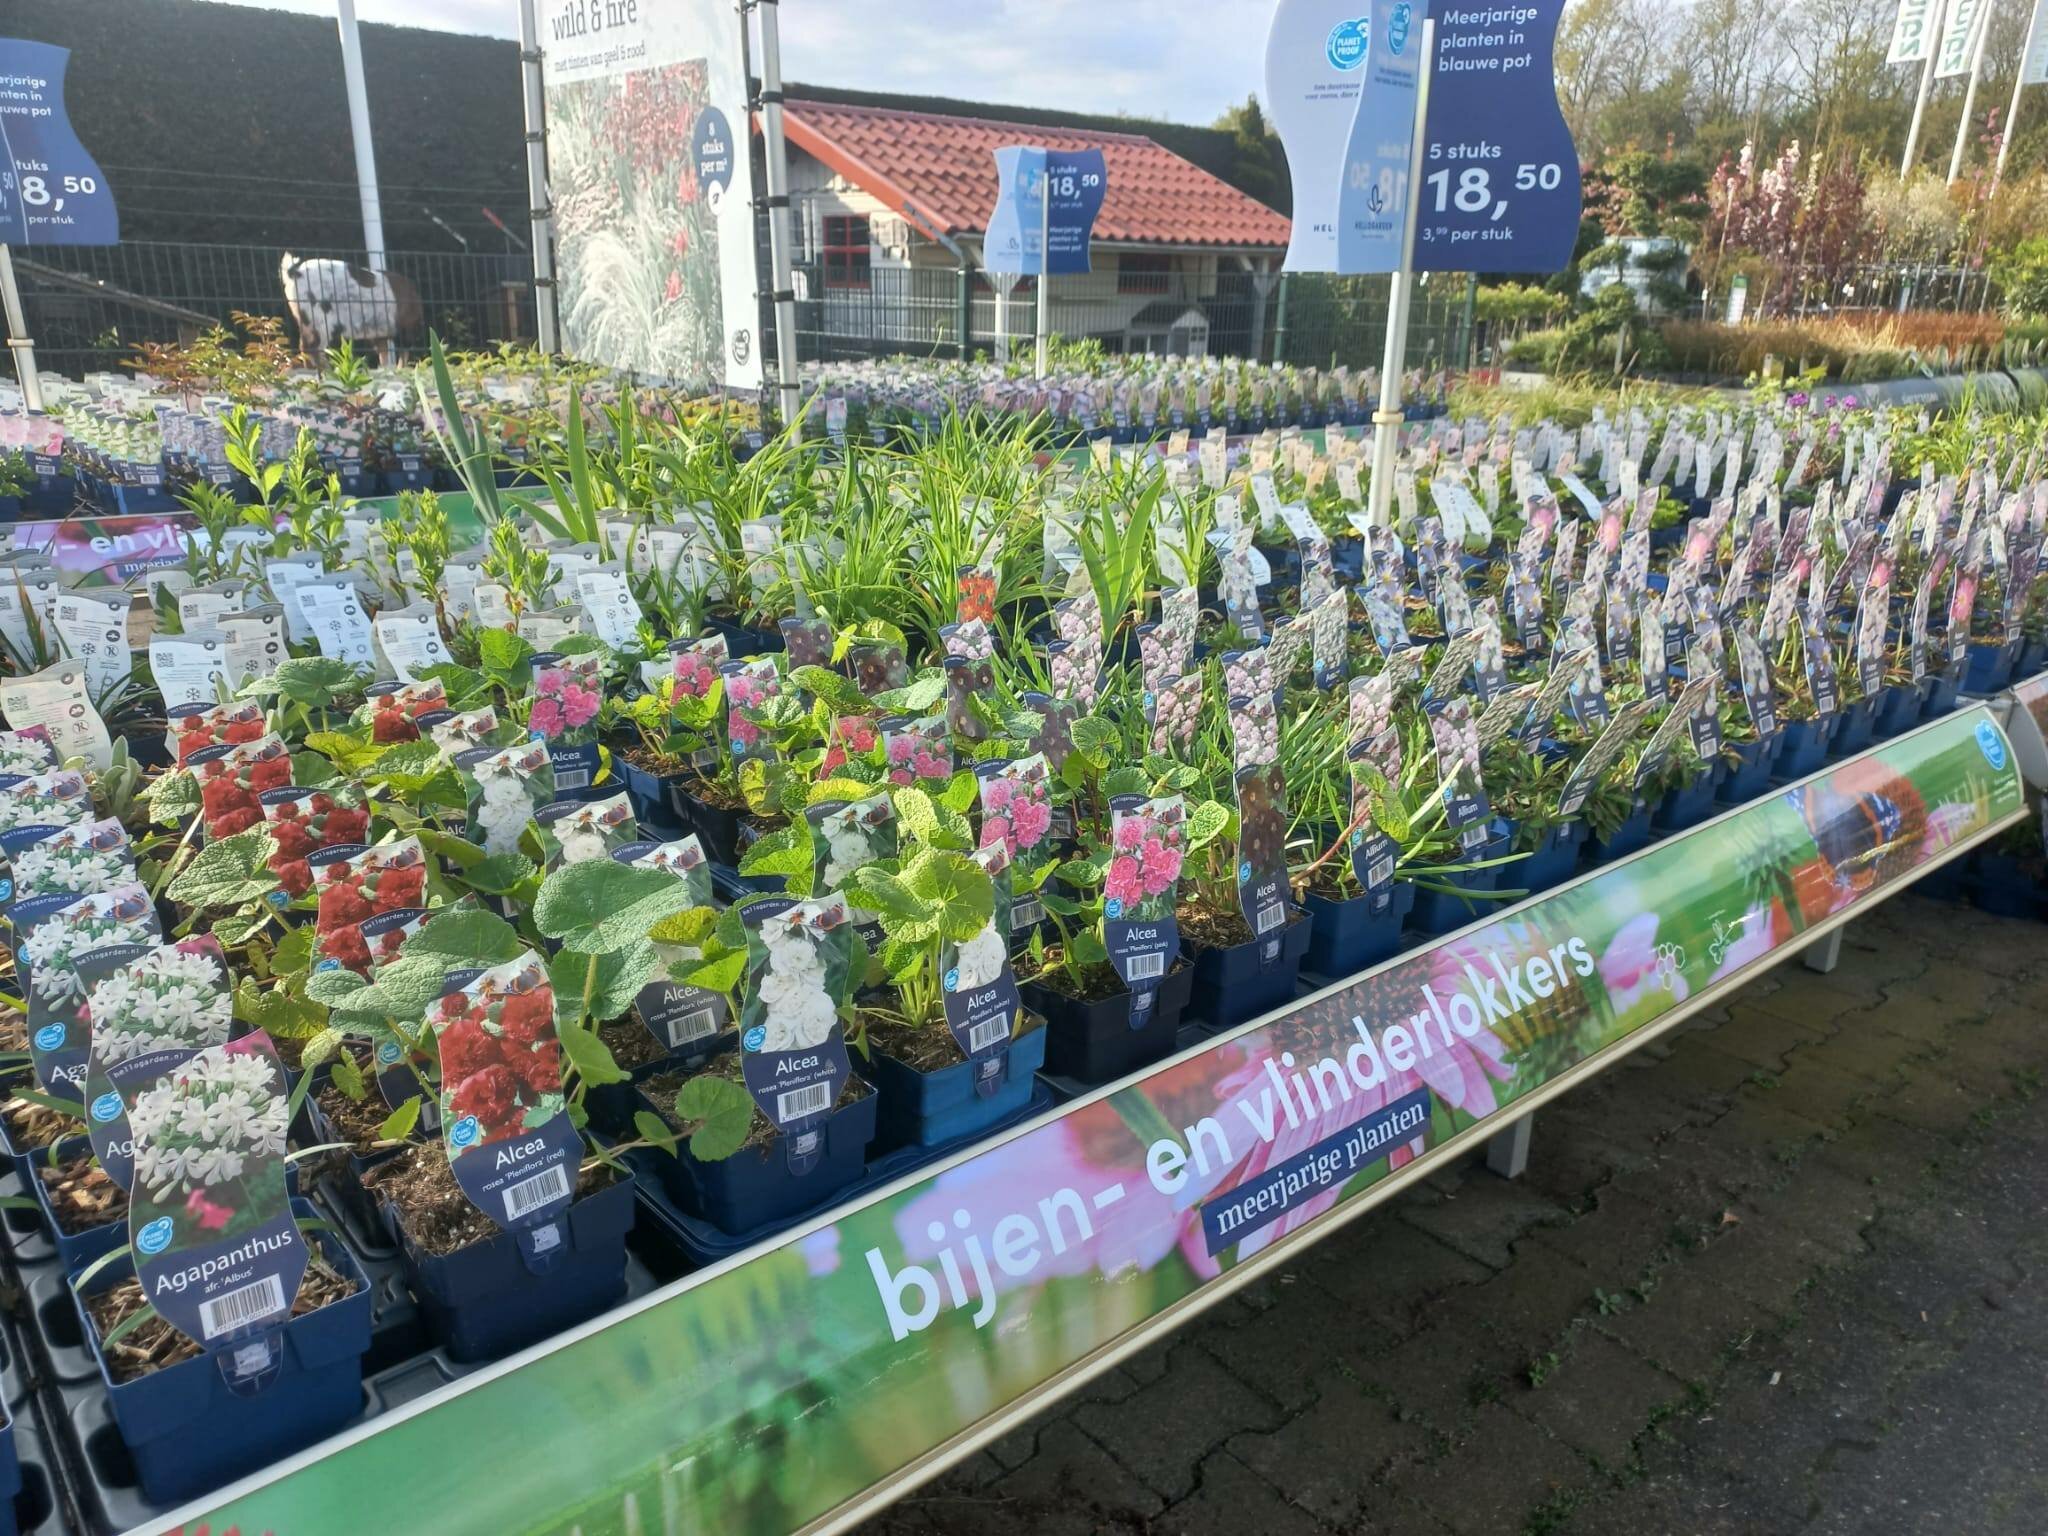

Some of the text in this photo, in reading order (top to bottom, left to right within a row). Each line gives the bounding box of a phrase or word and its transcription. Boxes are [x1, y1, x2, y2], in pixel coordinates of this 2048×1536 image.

[552, 2, 587, 41] wild
[591, 0, 602, 31] &
[1443, 5, 1538, 27] Meerjarige
[1440, 29, 1525, 53] planten in
[1439, 53, 1532, 73] blauwe pot
[30, 90, 42, 102] in
[31, 106, 52, 118] pot
[1429, 141, 1502, 159] 5 stuks
[29, 213, 75, 227] per stuk
[1450, 229, 1478, 243] per
[1481, 226, 1513, 241] stuk
[90, 535, 136, 555] en
[551, 751, 581, 763] Alcea
[1256, 882, 1277, 900] Alcea
[1126, 927, 1158, 943] Alcea
[663, 983, 701, 1006] Alcea
[967, 990, 997, 1013] Alcea
[775, 1055, 819, 1077] Alcea
[864, 934, 1595, 1343] bijen- en vlinderlokkers
[495, 1135, 546, 1171] Alcea
[546, 1148, 566, 1165] (red)
[1216, 1103, 1425, 1236] meerjarige planten
[155, 1230, 294, 1296] Agapanthus
